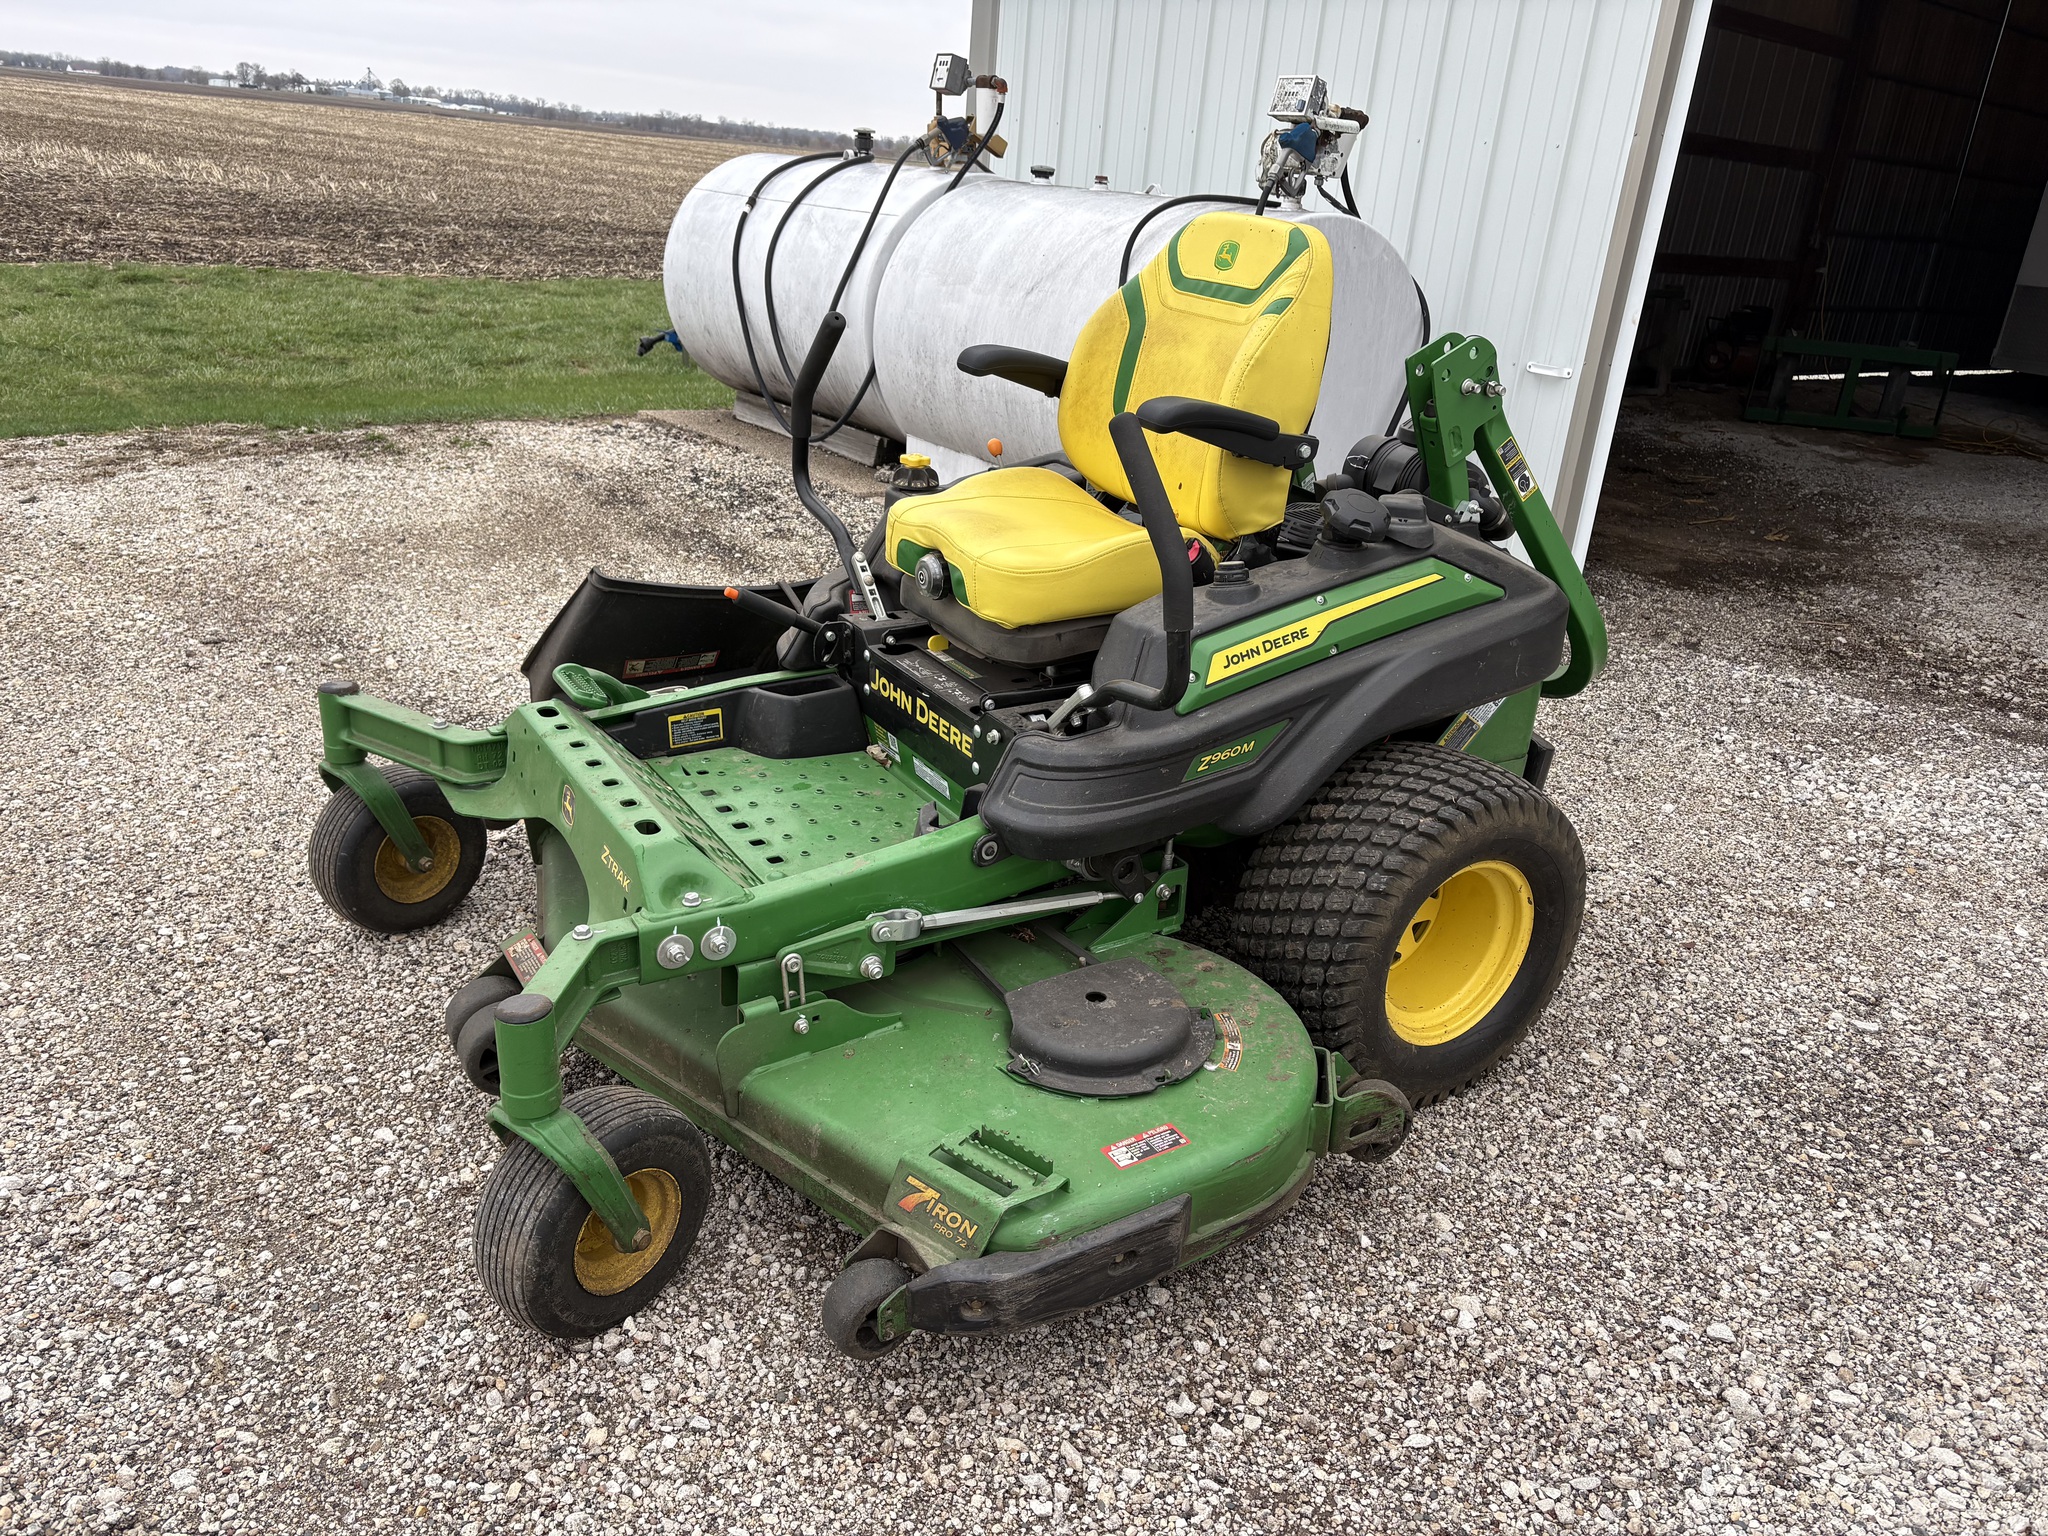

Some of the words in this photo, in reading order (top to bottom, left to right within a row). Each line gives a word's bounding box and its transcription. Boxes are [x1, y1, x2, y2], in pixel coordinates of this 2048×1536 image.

[1223, 645, 1261, 669] JOHN
[1262, 627, 1309, 653] DEERE
[871, 669, 912, 715] JOHN
[916, 697, 973, 758] DEERE
[1197, 740, 1255, 772] Z960M
[601, 844, 630, 893] ZTRAK
[1115, 1137, 1137, 1148] DANGER
[1147, 1125, 1169, 1136] PELIGRO
[933, 1223, 953, 1239] PRO
[955, 1236, 968, 1248] 72
